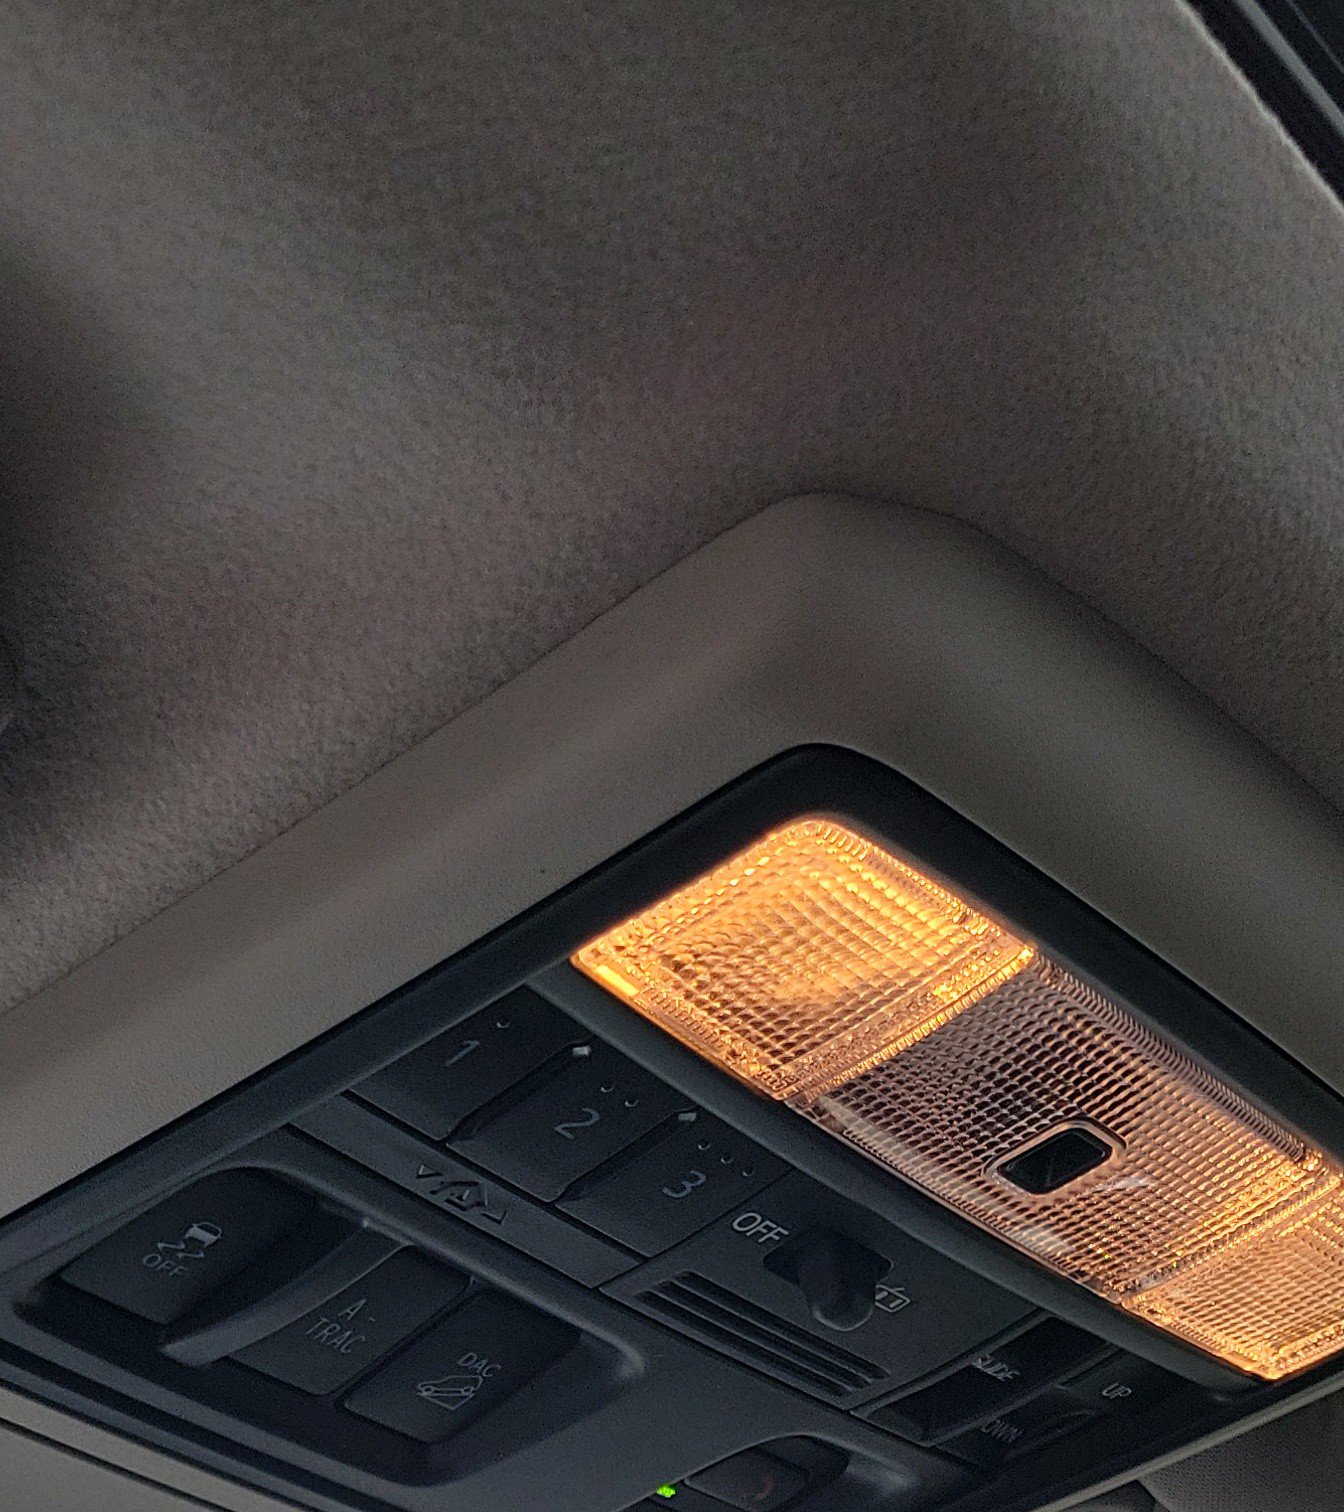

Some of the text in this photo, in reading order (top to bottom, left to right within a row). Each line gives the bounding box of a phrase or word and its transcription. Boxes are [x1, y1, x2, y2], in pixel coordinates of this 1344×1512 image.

[444, 1040, 481, 1067] 1
[555, 1107, 600, 1140] 2
[662, 1170, 707, 1200] 3
[732, 1212, 789, 1246] OFF
[142, 1253, 189, 1277] OFF
[305, 1316, 367, 1354] TRAC
[457, 1351, 502, 1378] DAC
[1102, 1382, 1132, 1399] UP
